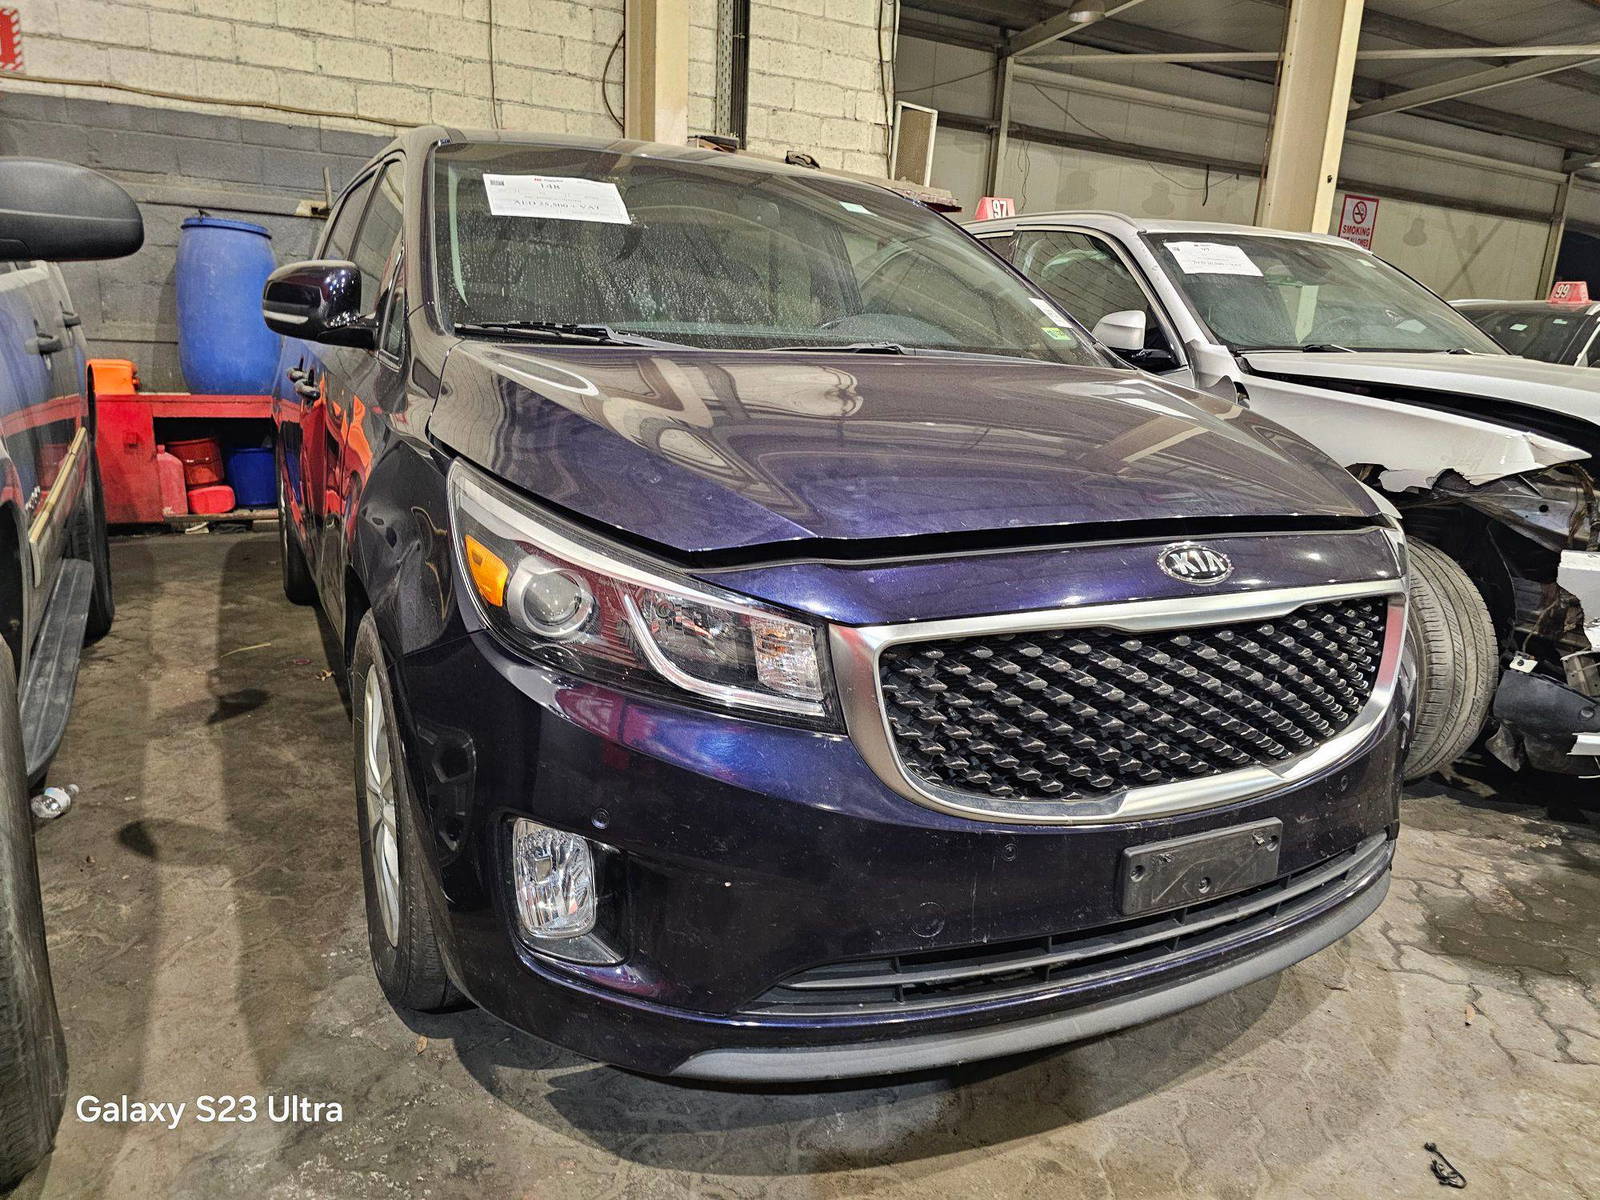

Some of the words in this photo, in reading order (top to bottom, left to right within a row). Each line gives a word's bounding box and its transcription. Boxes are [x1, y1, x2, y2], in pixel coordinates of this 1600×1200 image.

[992, 199, 1008, 219] 97
[1342, 225, 1370, 236] SMOKING
[1555, 284, 1570, 298] 99
[1169, 550, 1226, 575] KIA
